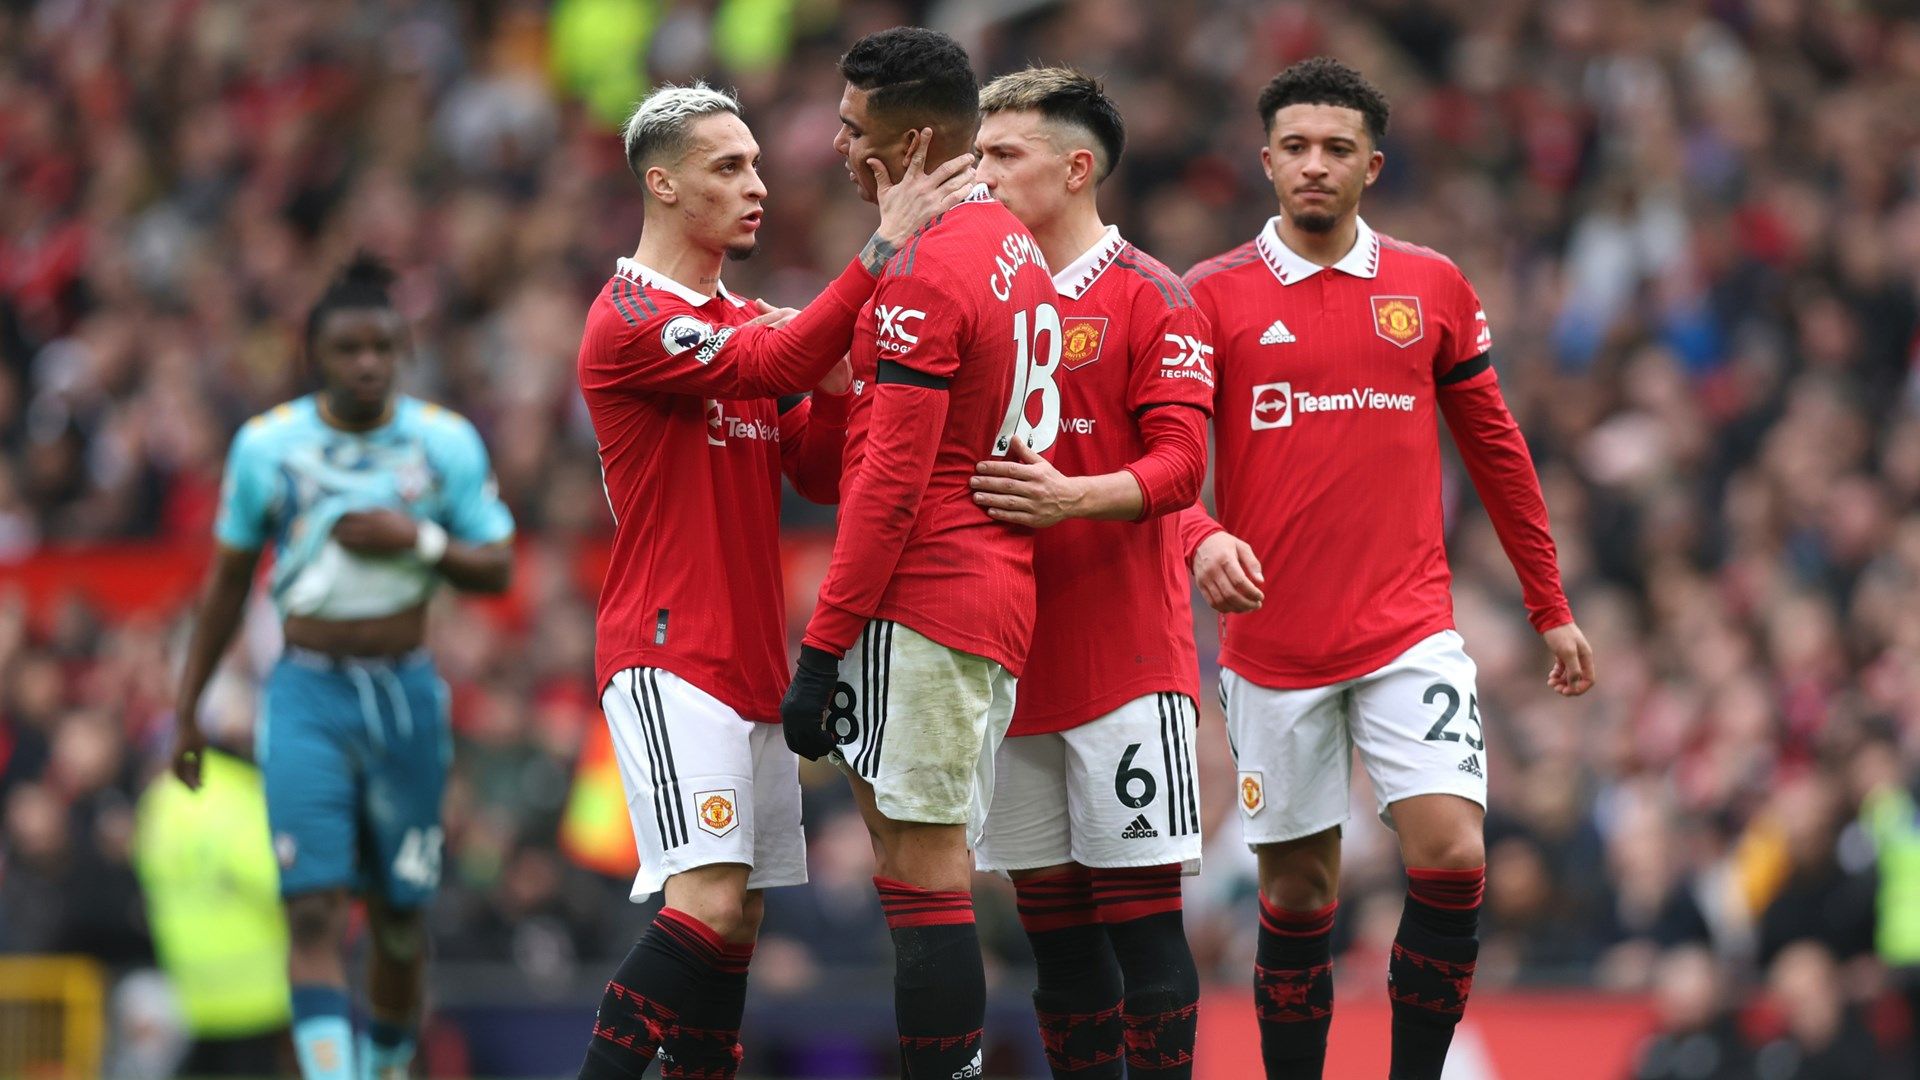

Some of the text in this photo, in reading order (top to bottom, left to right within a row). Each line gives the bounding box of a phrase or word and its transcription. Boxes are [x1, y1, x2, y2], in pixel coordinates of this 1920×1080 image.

[990, 233, 1051, 301] CASEMI
[991, 303, 1062, 457] 18
[1162, 333, 1214, 378] DXC
[1293, 387, 1416, 413] TeamViewer
[826, 681, 860, 745] 8
[1422, 683, 1484, 752] 25
[1114, 743, 1157, 809] 6
[1121, 828, 1159, 839] adidas
[952, 1065, 982, 1080] adid
